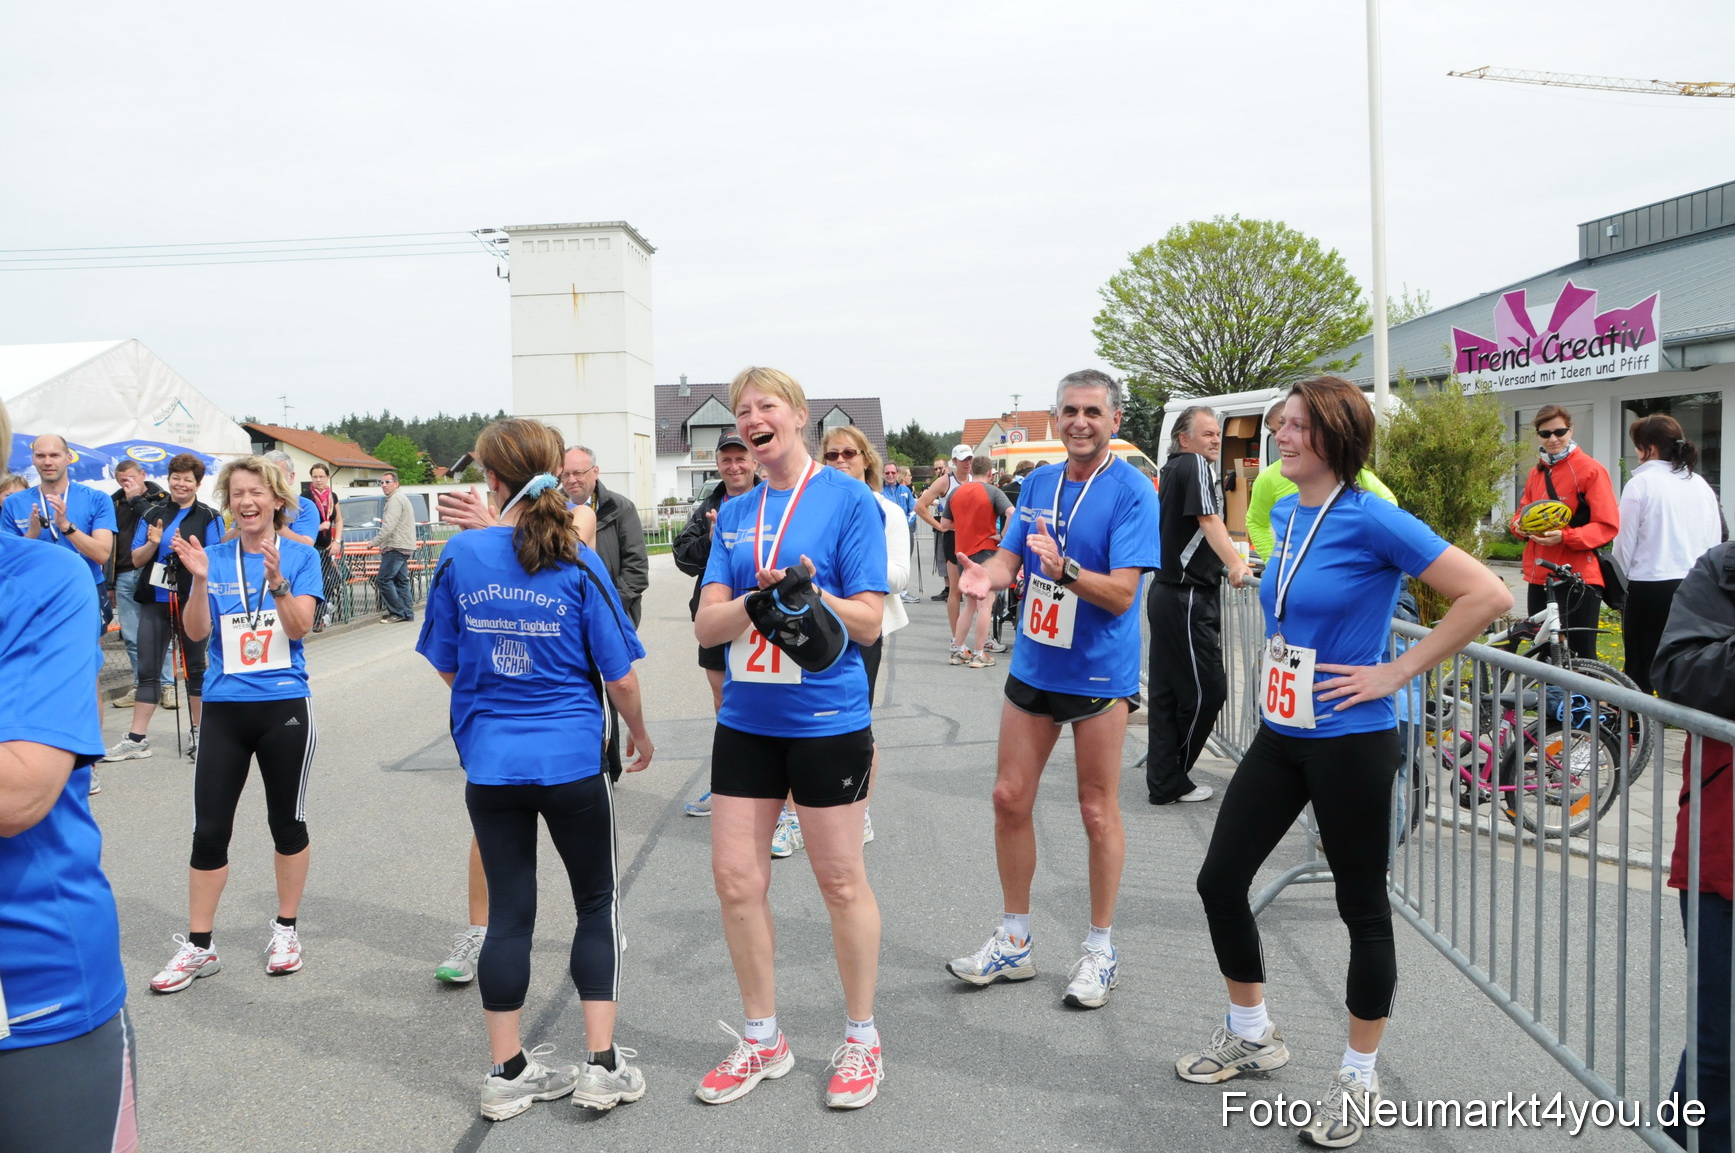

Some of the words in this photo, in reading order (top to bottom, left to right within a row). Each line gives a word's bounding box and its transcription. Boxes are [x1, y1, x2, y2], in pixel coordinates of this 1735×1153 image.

[1461, 336, 1531, 374] Trend
[1542, 320, 1645, 363] Creativ
[1540, 369, 1556, 382] mit
[1560, 365, 1591, 379] Ideen
[1596, 360, 1615, 375] und
[1620, 354, 1650, 371] Pfiff
[458, 583, 568, 616] FunRunner's
[232, 614, 262, 625] MEYR
[465, 614, 517, 630] Neumarkter
[518, 619, 561, 632] Tagblatt
[1029, 597, 1059, 639] 64
[494, 634, 526, 658] RUND
[494, 656, 533, 675] SCHAU
[1266, 666, 1296, 719] 65
